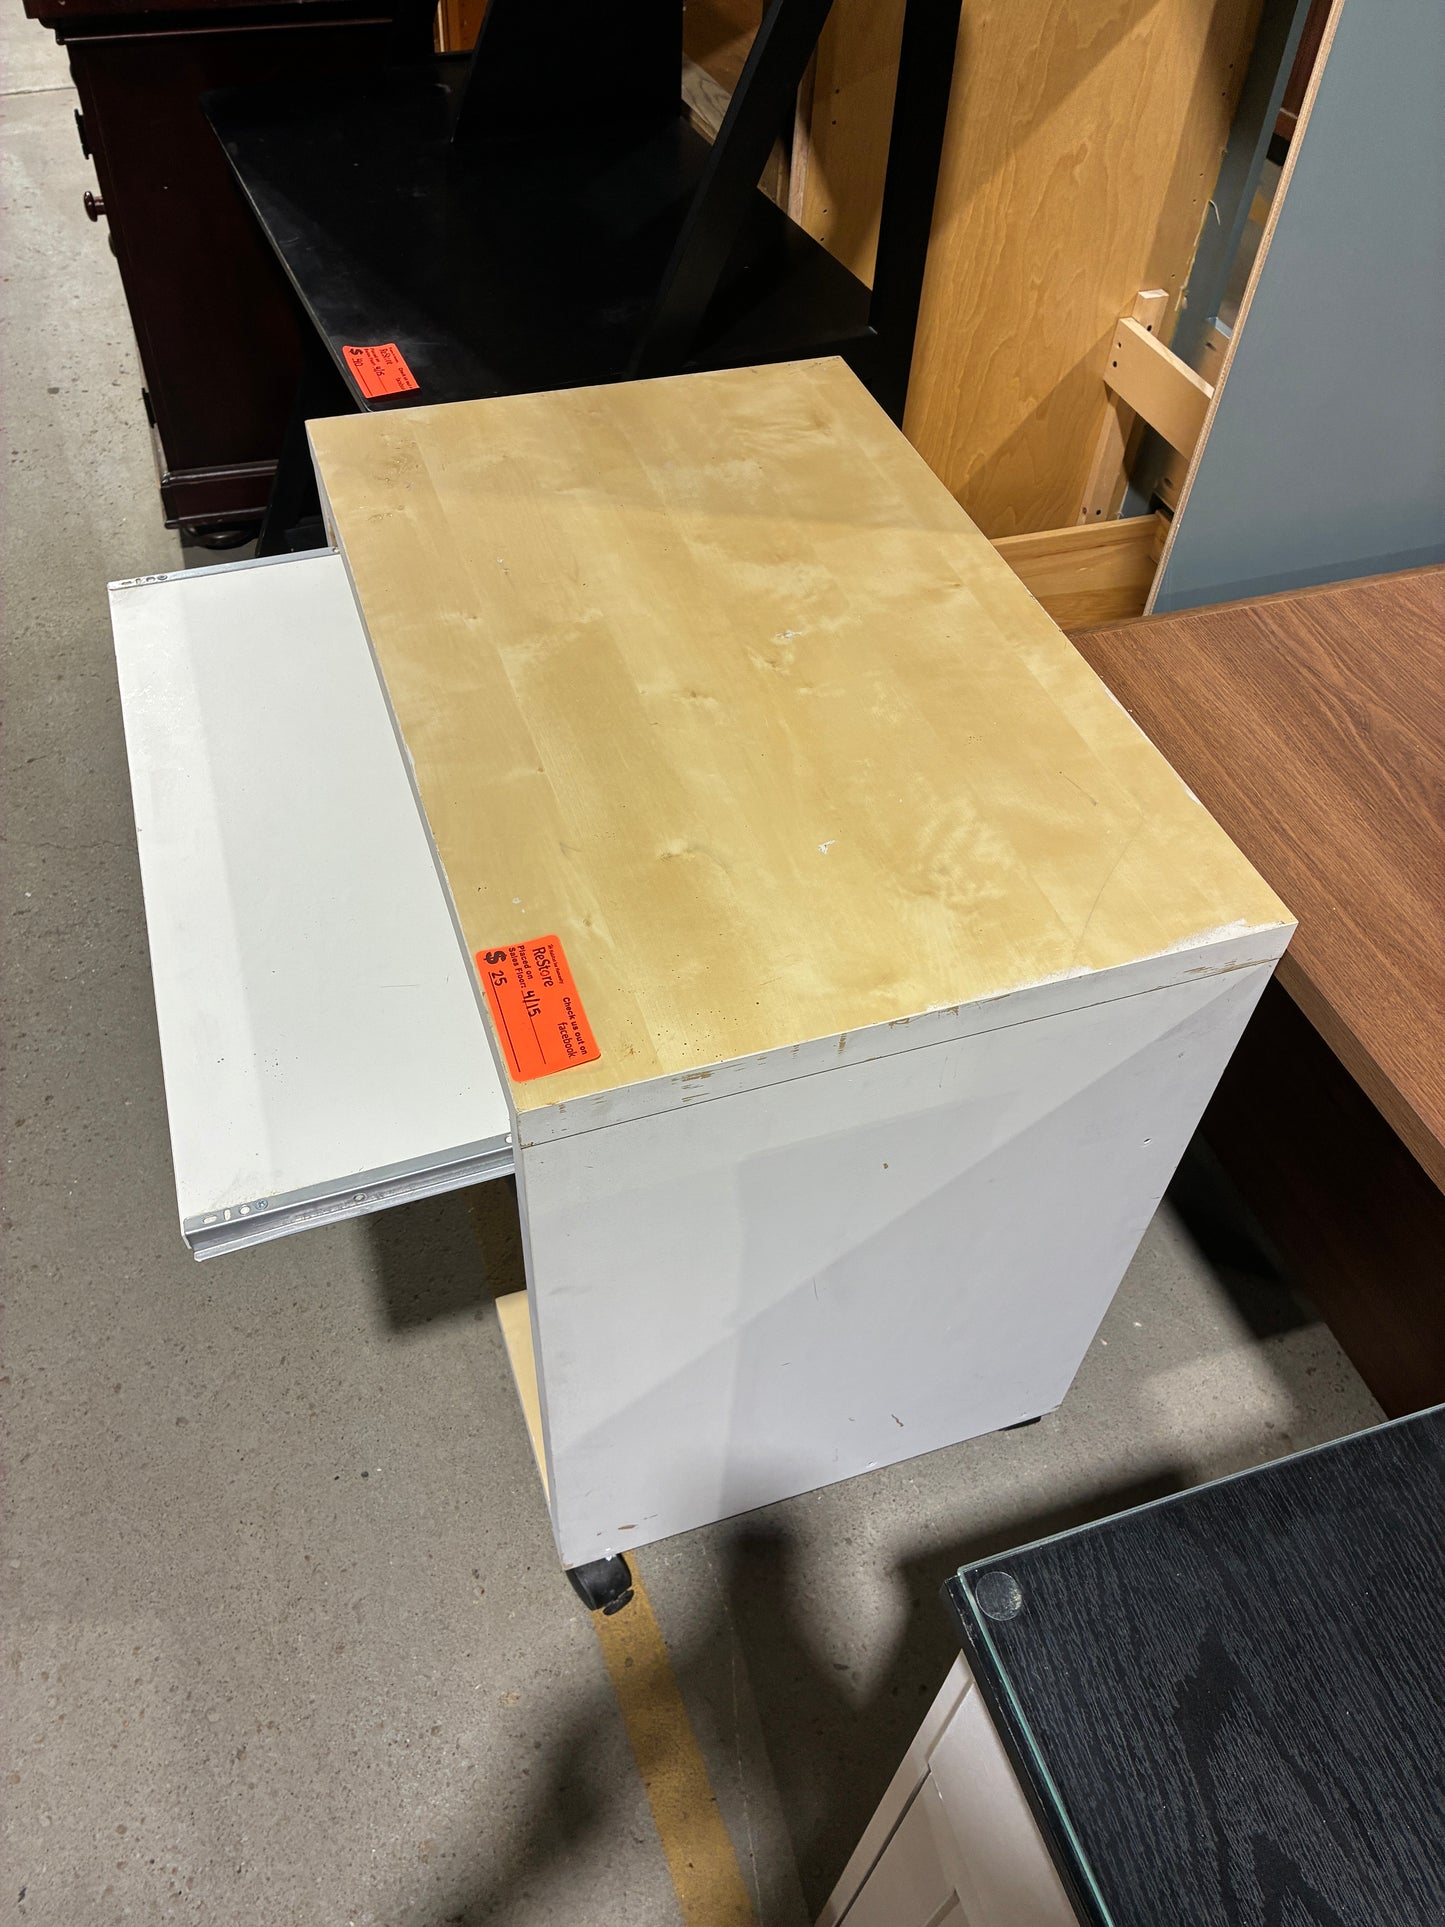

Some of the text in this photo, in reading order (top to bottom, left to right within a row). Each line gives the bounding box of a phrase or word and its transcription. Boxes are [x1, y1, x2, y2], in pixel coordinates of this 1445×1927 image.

[484, 951, 507, 986] $ 25
[518, 945, 533, 979] Placed on
[533, 946, 554, 987] ReStore
[509, 948, 541, 1017] Sales Floor: 4/15
[558, 1022, 577, 1058] facebook
[563, 997, 587, 1055] Check us out on
